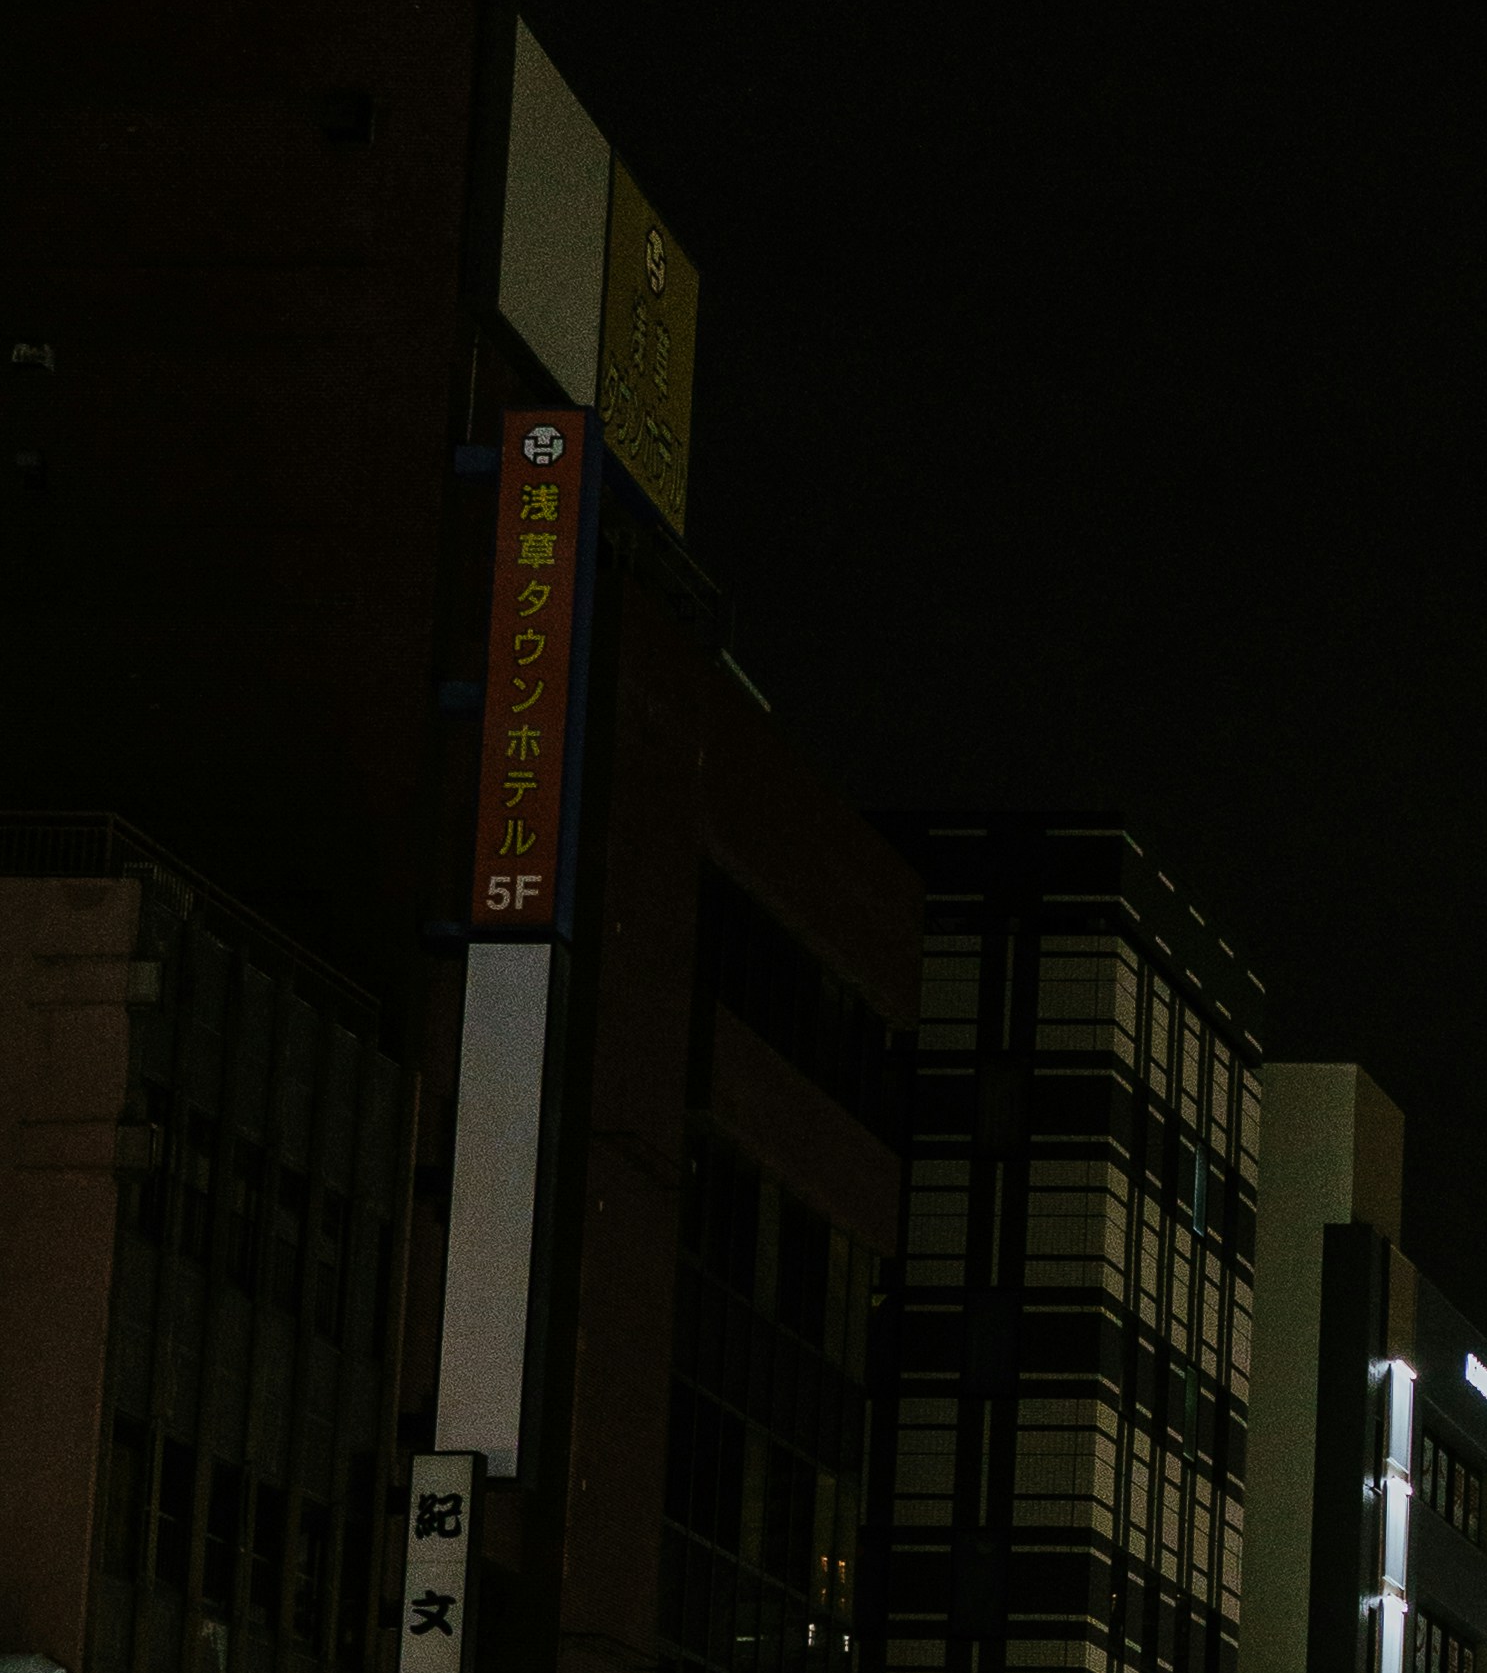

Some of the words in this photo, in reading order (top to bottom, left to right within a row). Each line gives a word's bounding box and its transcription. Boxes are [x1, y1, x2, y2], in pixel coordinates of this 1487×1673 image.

[499, 482, 559, 861] 浅草タウンホテル
[486, 875, 544, 913] 5F
